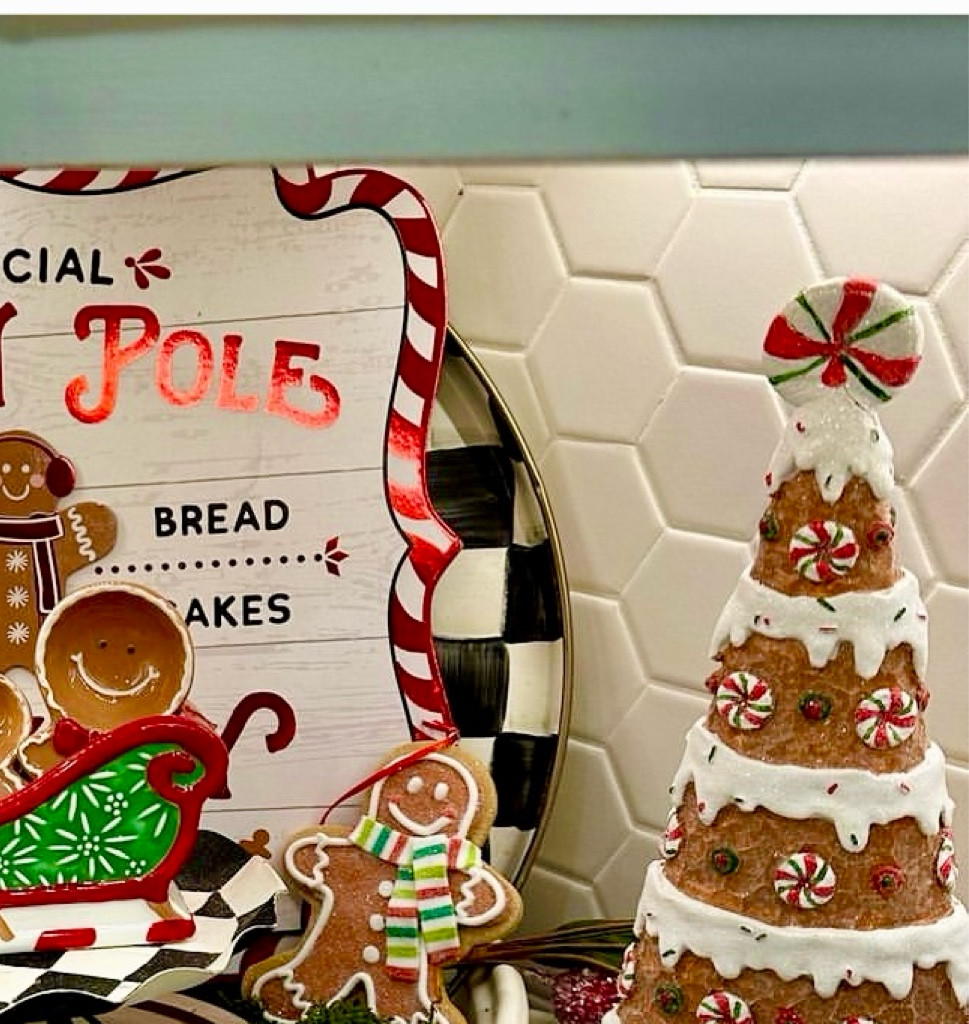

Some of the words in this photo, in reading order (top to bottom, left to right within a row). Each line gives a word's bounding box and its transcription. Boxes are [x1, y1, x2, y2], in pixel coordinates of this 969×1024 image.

[63, 303, 342, 429] POLE
[155, 499, 290, 538] BREAD
[172, 593, 291, 629] AKES
